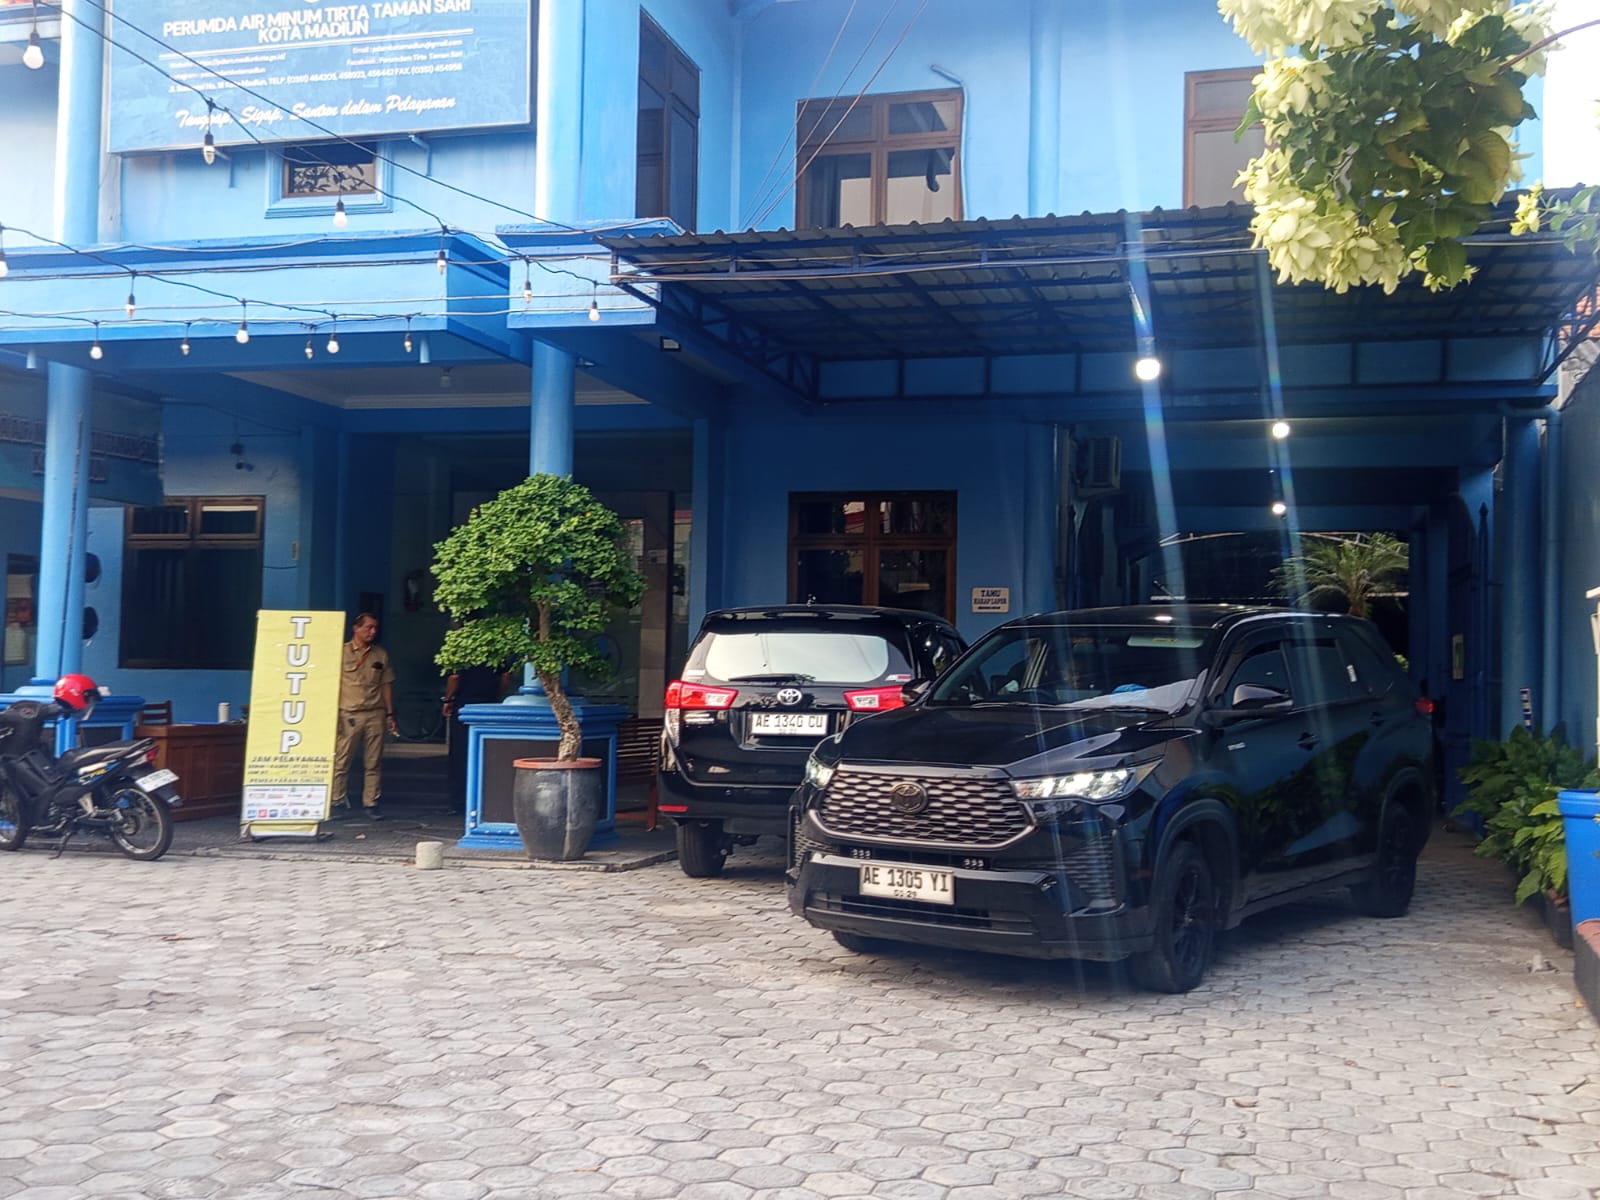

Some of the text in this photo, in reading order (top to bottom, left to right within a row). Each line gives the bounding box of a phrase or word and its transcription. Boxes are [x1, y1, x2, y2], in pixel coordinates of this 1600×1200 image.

[163, 0, 471, 37] PERUMDA AIR MINUM TIRTA TAMAN SARI
[258, 20, 369, 43] KOTA MADIUN
[340, 98, 382, 115] dalam
[385, 94, 456, 114] Pelayanan
[280, 616, 312, 754] TUTUP
[755, 714, 770, 728] AE
[808, 714, 823, 728] CU
[863, 867, 949, 892] AE 1305 YI
